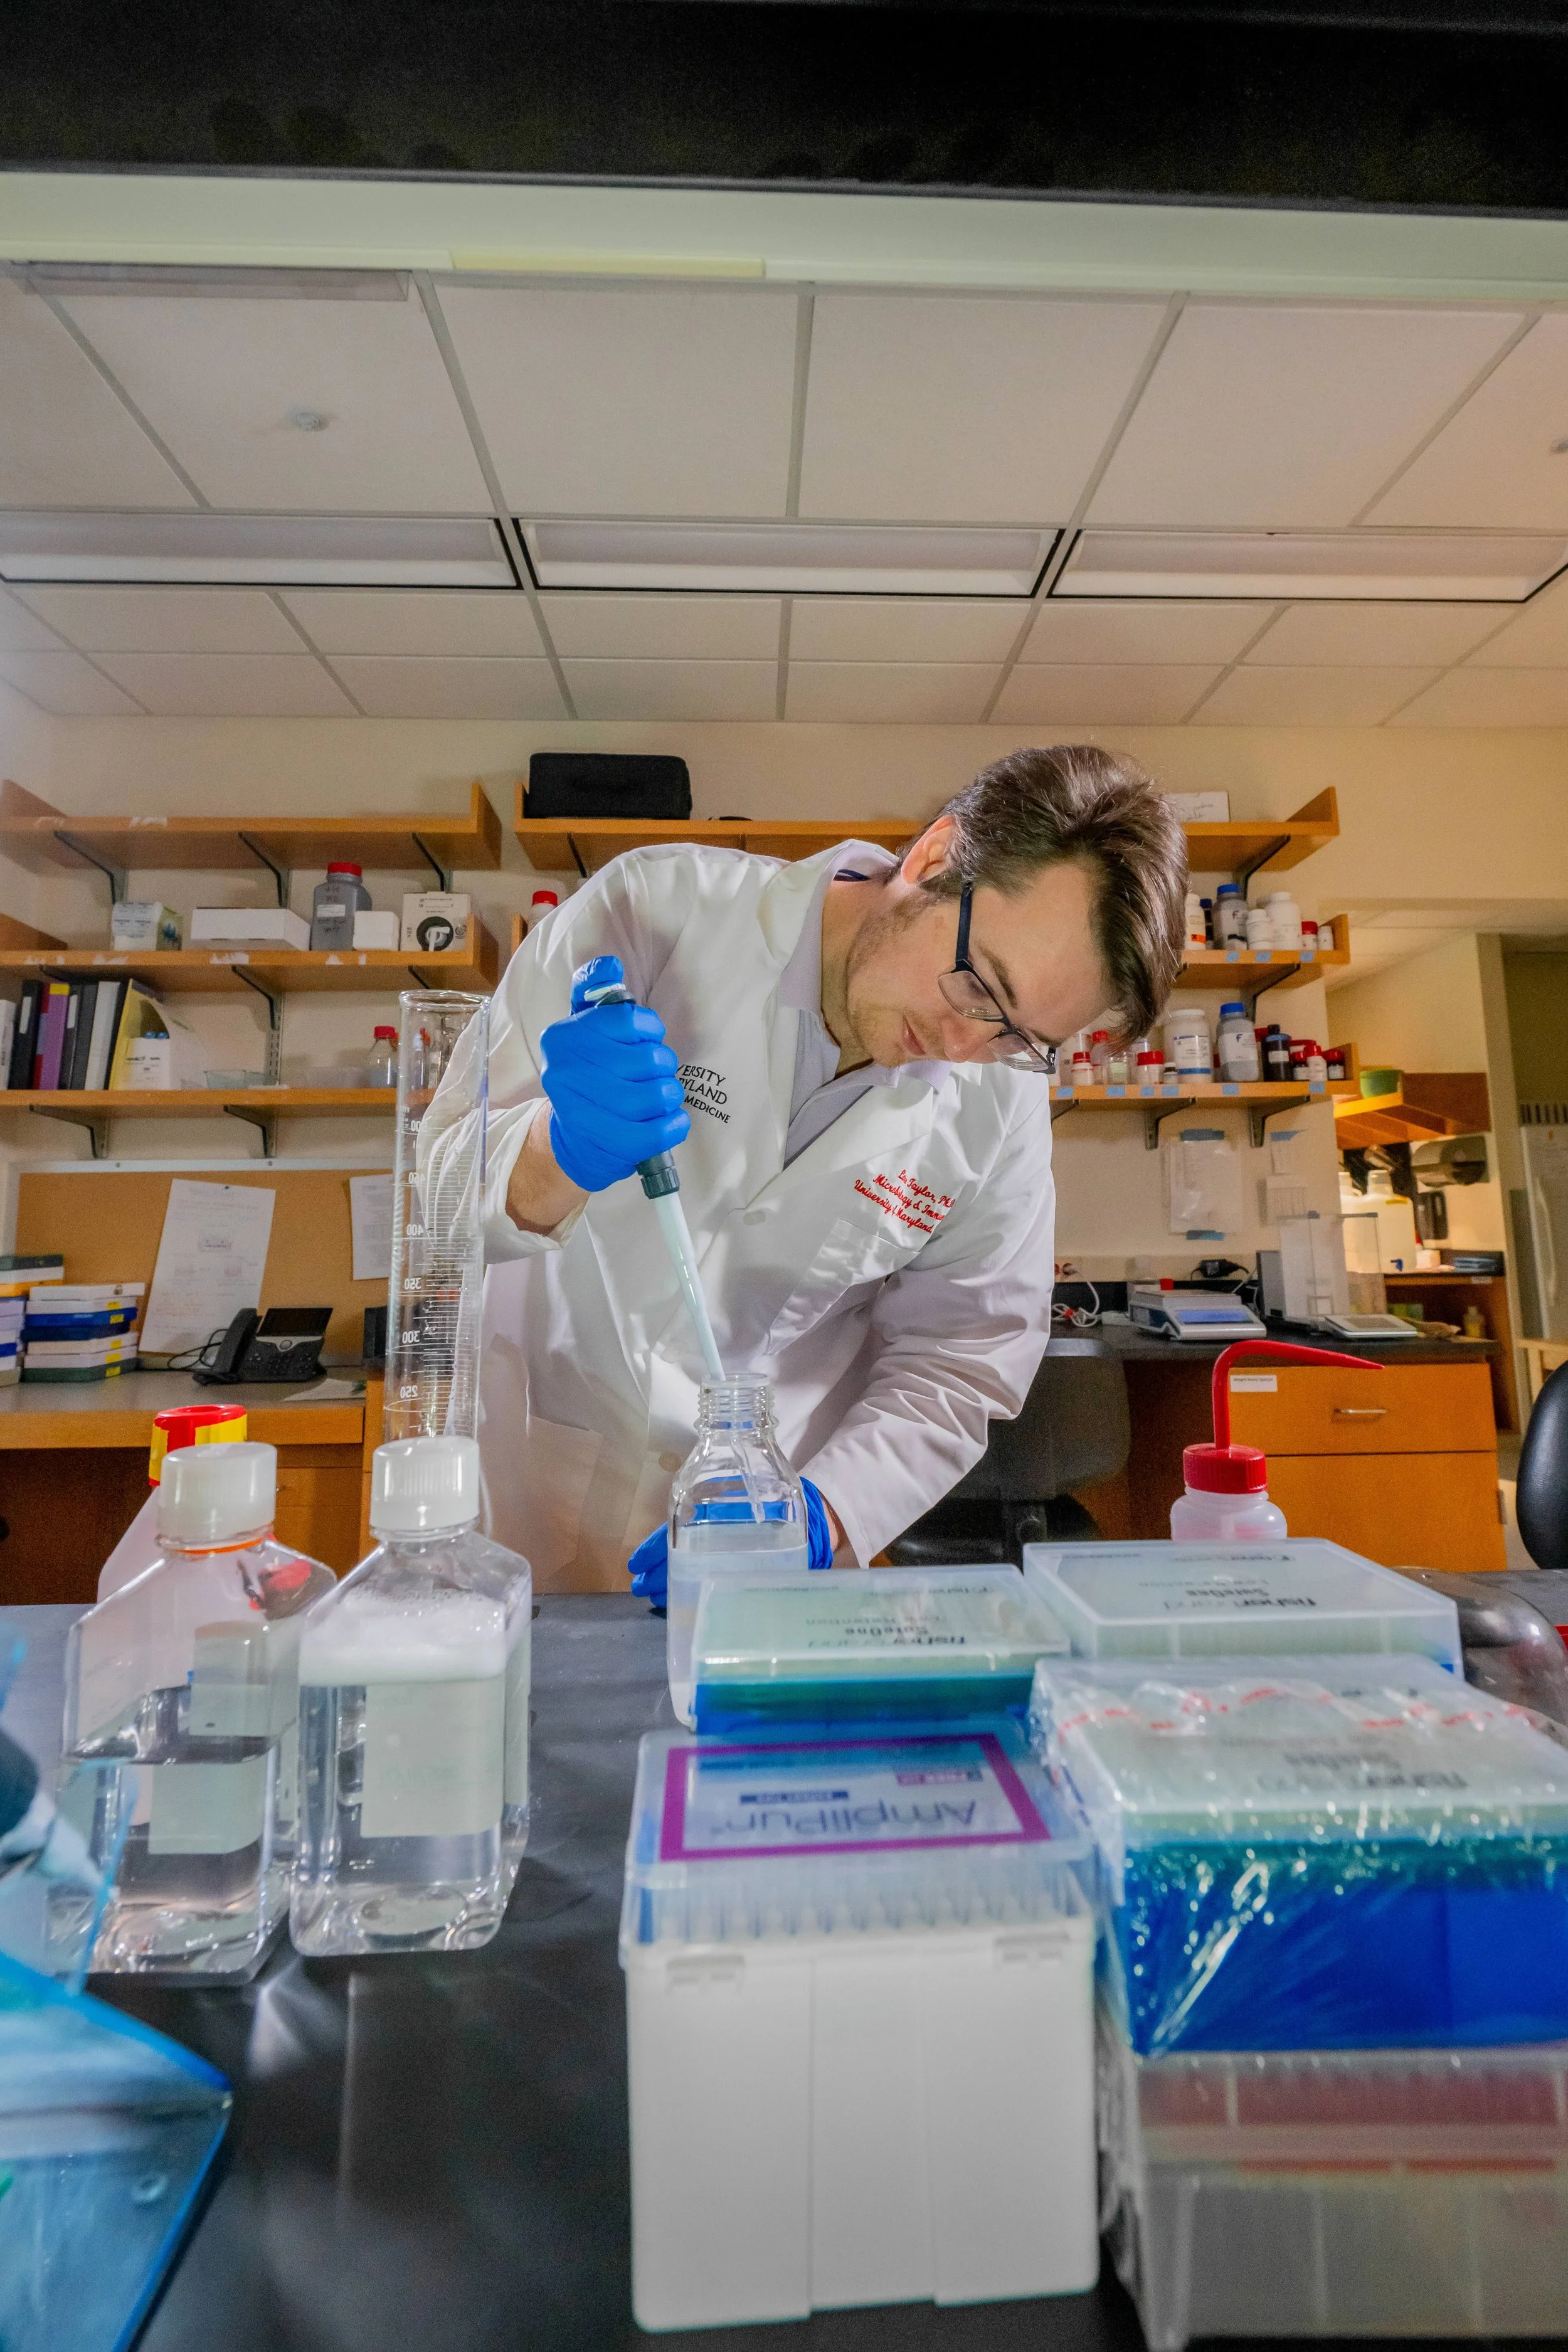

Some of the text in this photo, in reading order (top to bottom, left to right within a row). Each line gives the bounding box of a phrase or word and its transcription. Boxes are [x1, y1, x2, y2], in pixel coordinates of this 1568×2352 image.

[684, 1094, 731, 1123] MEDICINE
[854, 1179, 892, 1214] University
[913, 1200, 923, 1210] &
